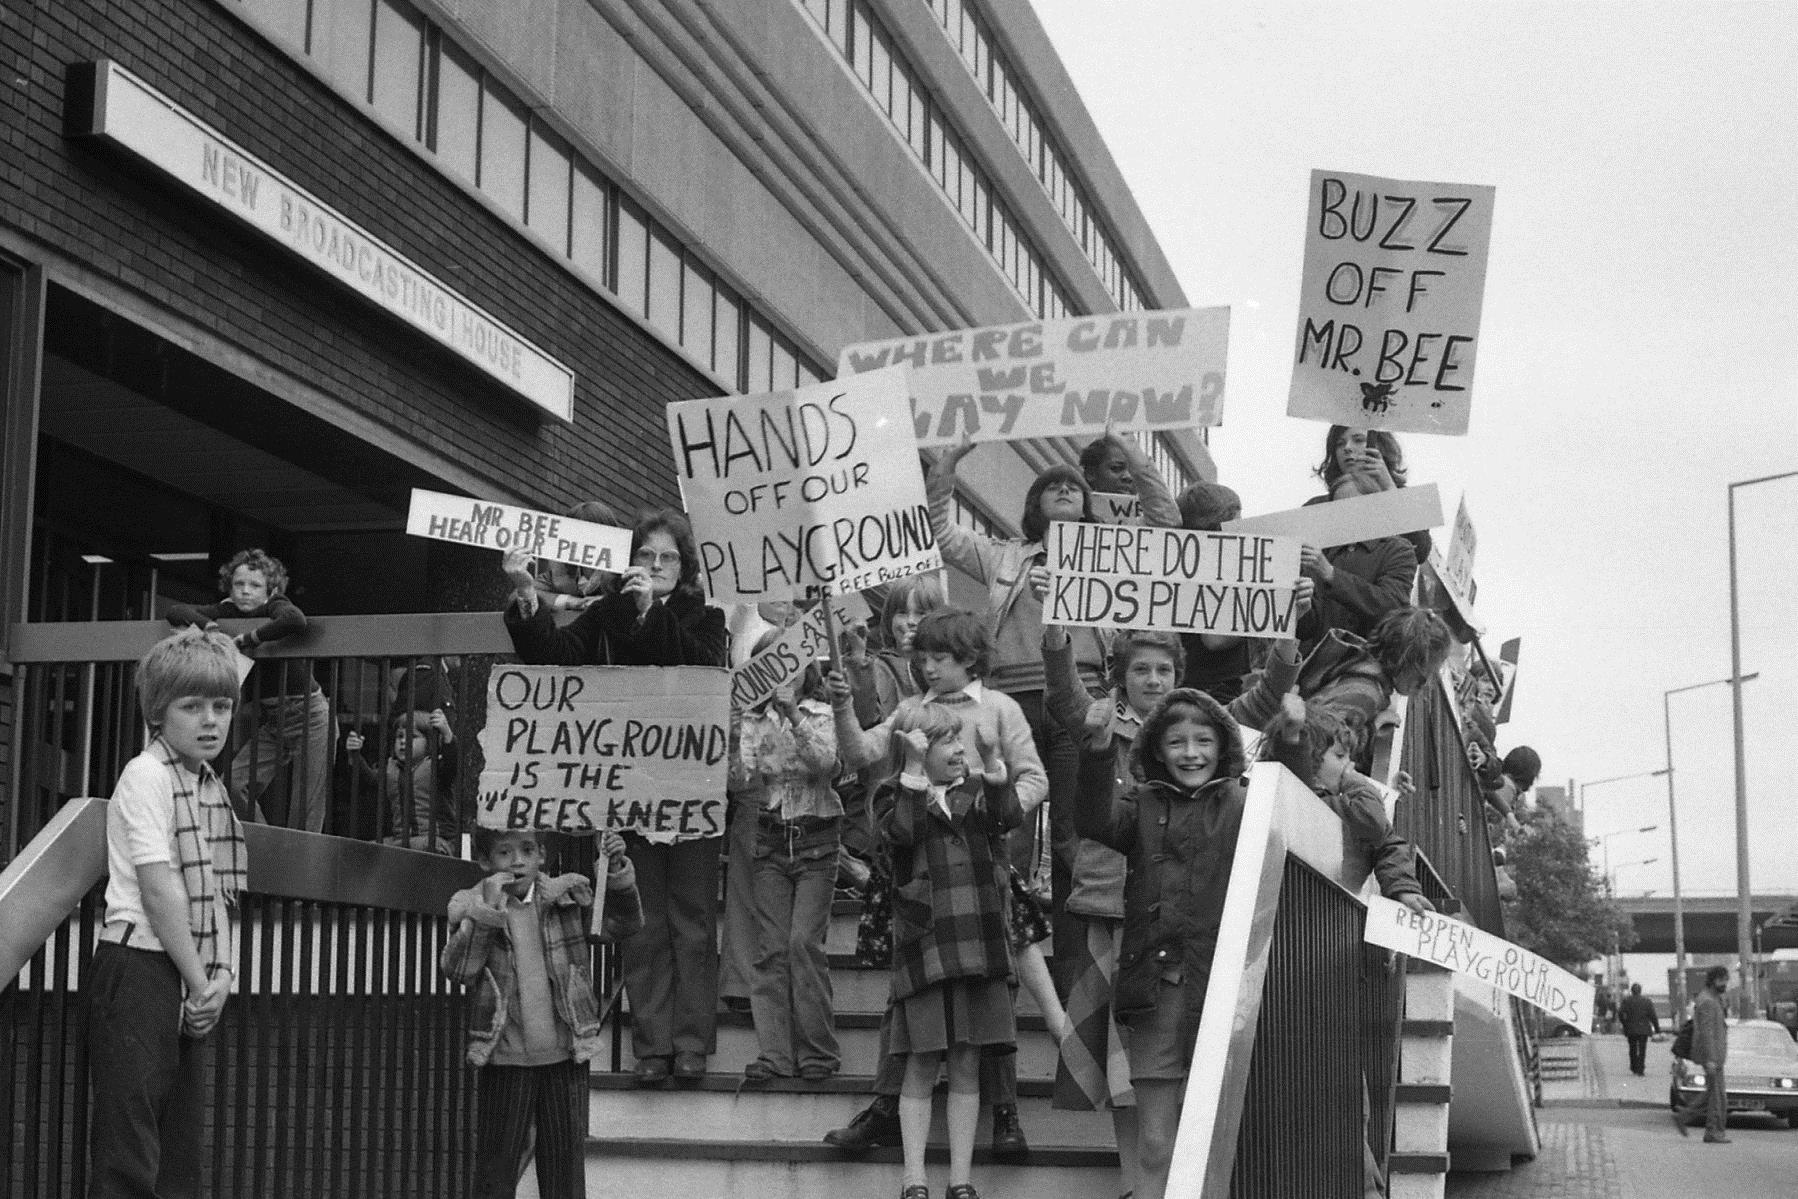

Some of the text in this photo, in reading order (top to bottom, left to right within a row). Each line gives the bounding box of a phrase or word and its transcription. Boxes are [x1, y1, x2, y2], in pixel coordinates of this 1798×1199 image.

[1320, 178, 1472, 256] BUZZ
[203, 143, 522, 379] NEW BROADCASTING HOUSE
[1325, 262, 1446, 312] OFF
[849, 318, 1186, 373] WHERE CAN
[1299, 317, 1474, 391] MR. BEE
[977, 362, 1067, 395] WE
[678, 393, 856, 479] HANDS
[724, 461, 869, 515] OFF OUR
[428, 514, 612, 569] HEAR OUR PLEA
[471, 503, 561, 538] MR BEE
[700, 504, 935, 598] PLAYGROUND
[1057, 523, 1274, 583] WHERE DO THE
[1052, 575, 1297, 633] KIDS PLAY NOW
[496, 671, 585, 712] OUR
[505, 717, 727, 766] PLAYGROUND
[510, 761, 632, 790] IS THE
[606, 798, 721, 835] KNEES
[1396, 908, 1550, 984] REOPEN OUR
[1418, 931, 1579, 1022] PLAYGROUNDS
